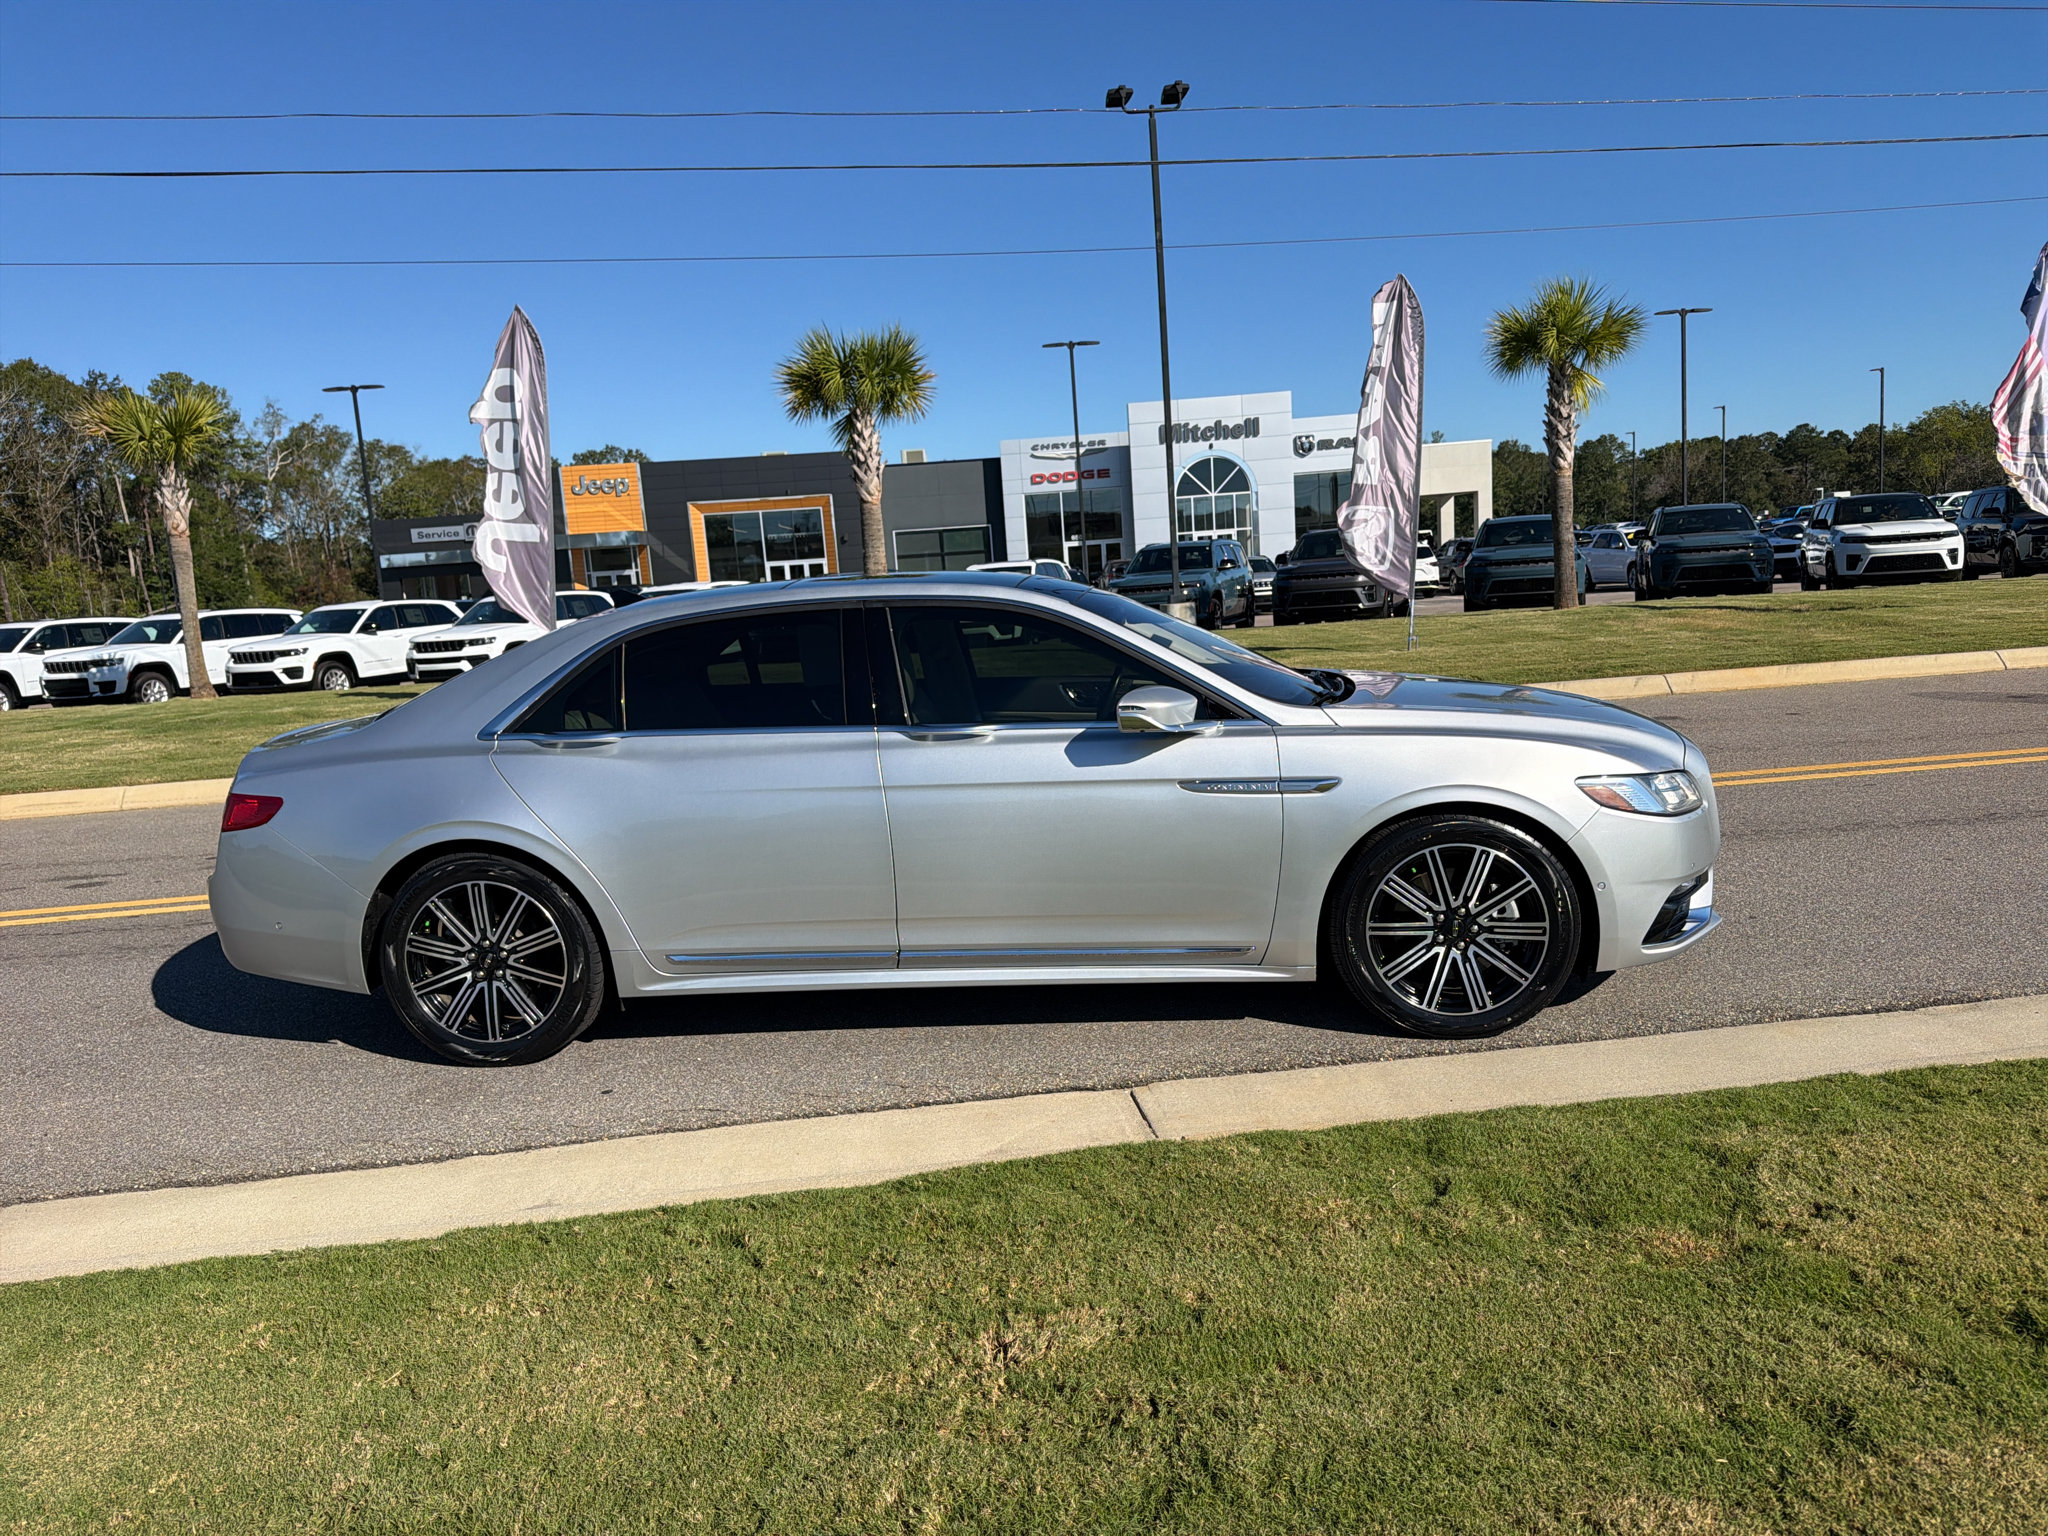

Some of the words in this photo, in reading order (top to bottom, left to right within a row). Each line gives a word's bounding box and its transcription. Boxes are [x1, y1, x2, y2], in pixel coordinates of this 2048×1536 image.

[1158, 417, 1260, 445] Mitchell
[1030, 439, 1107, 451] CHRYSLER
[1316, 436, 1357, 451] RA
[1031, 468, 1111, 485] DODGE
[571, 475, 629, 497] Jeep
[417, 530, 459, 539] Service
